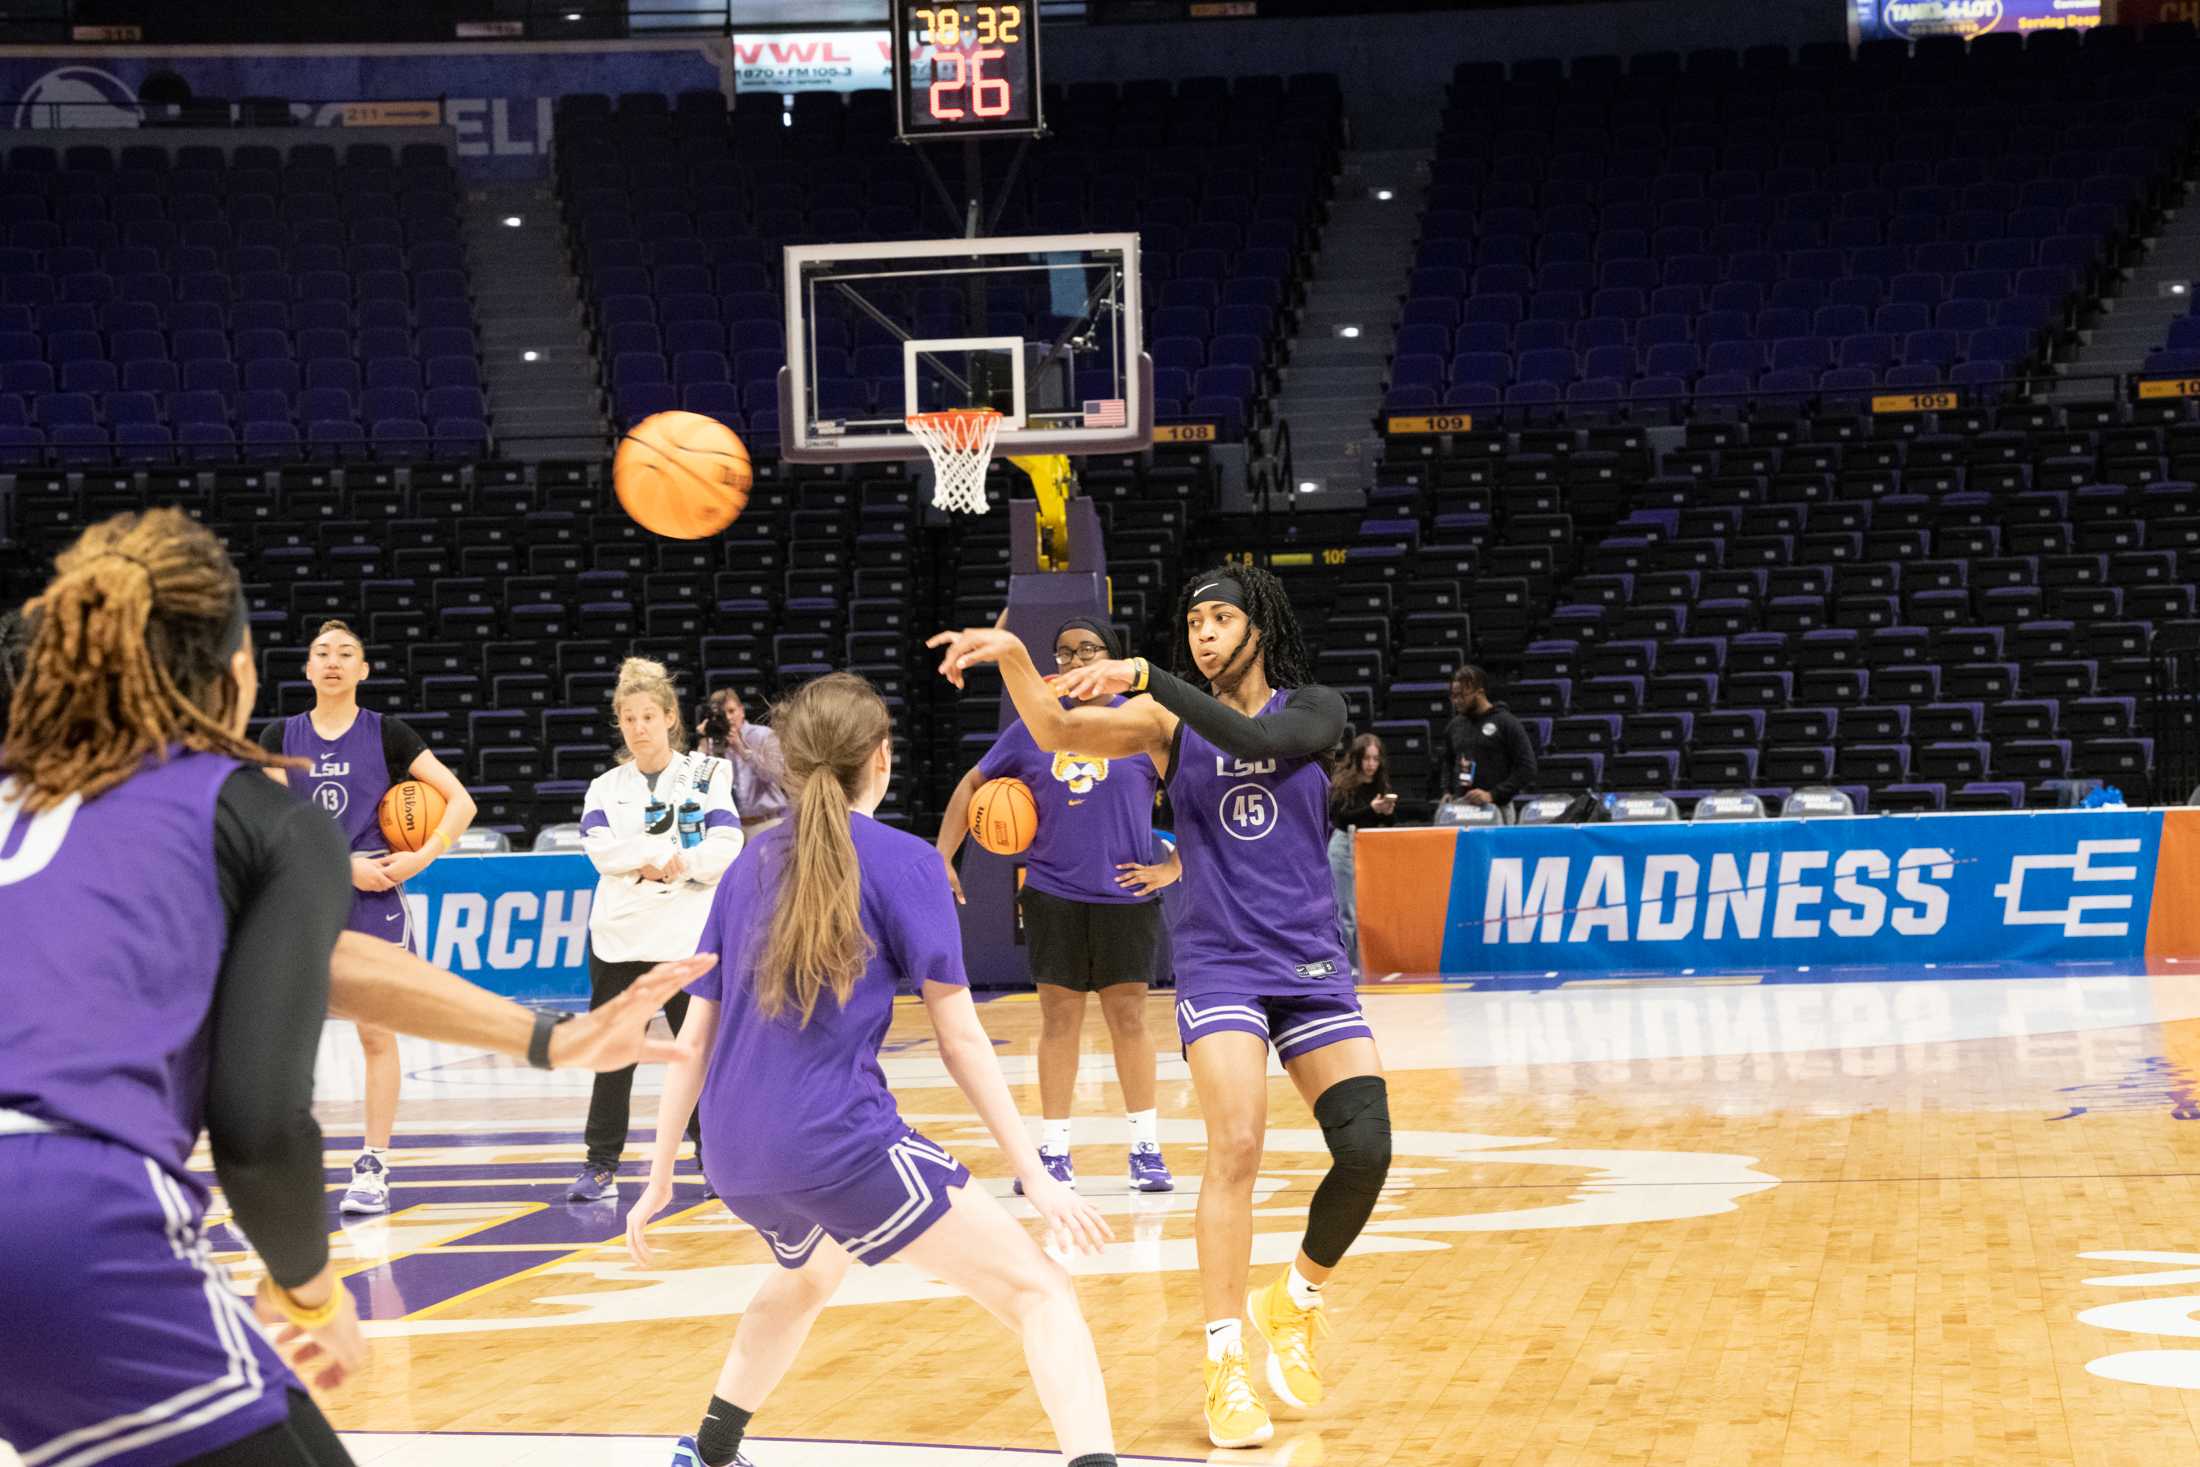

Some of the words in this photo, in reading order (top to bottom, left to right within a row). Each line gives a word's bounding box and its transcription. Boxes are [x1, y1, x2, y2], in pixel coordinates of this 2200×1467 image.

[930, 49, 1010, 119] 26
[348, 107, 379, 121] 211
[1909, 395, 1949, 408] 109
[1168, 426, 1208, 440] 108
[1425, 416, 1463, 430] 109
[309, 762, 350, 777] LSU
[1216, 755, 1276, 777] LSU
[321, 789, 339, 810] 13
[403, 785, 416, 831] Wilson
[1233, 794, 1265, 827] 45
[1482, 847, 1954, 945] MADNESS
[405, 889, 593, 971] ARCH
